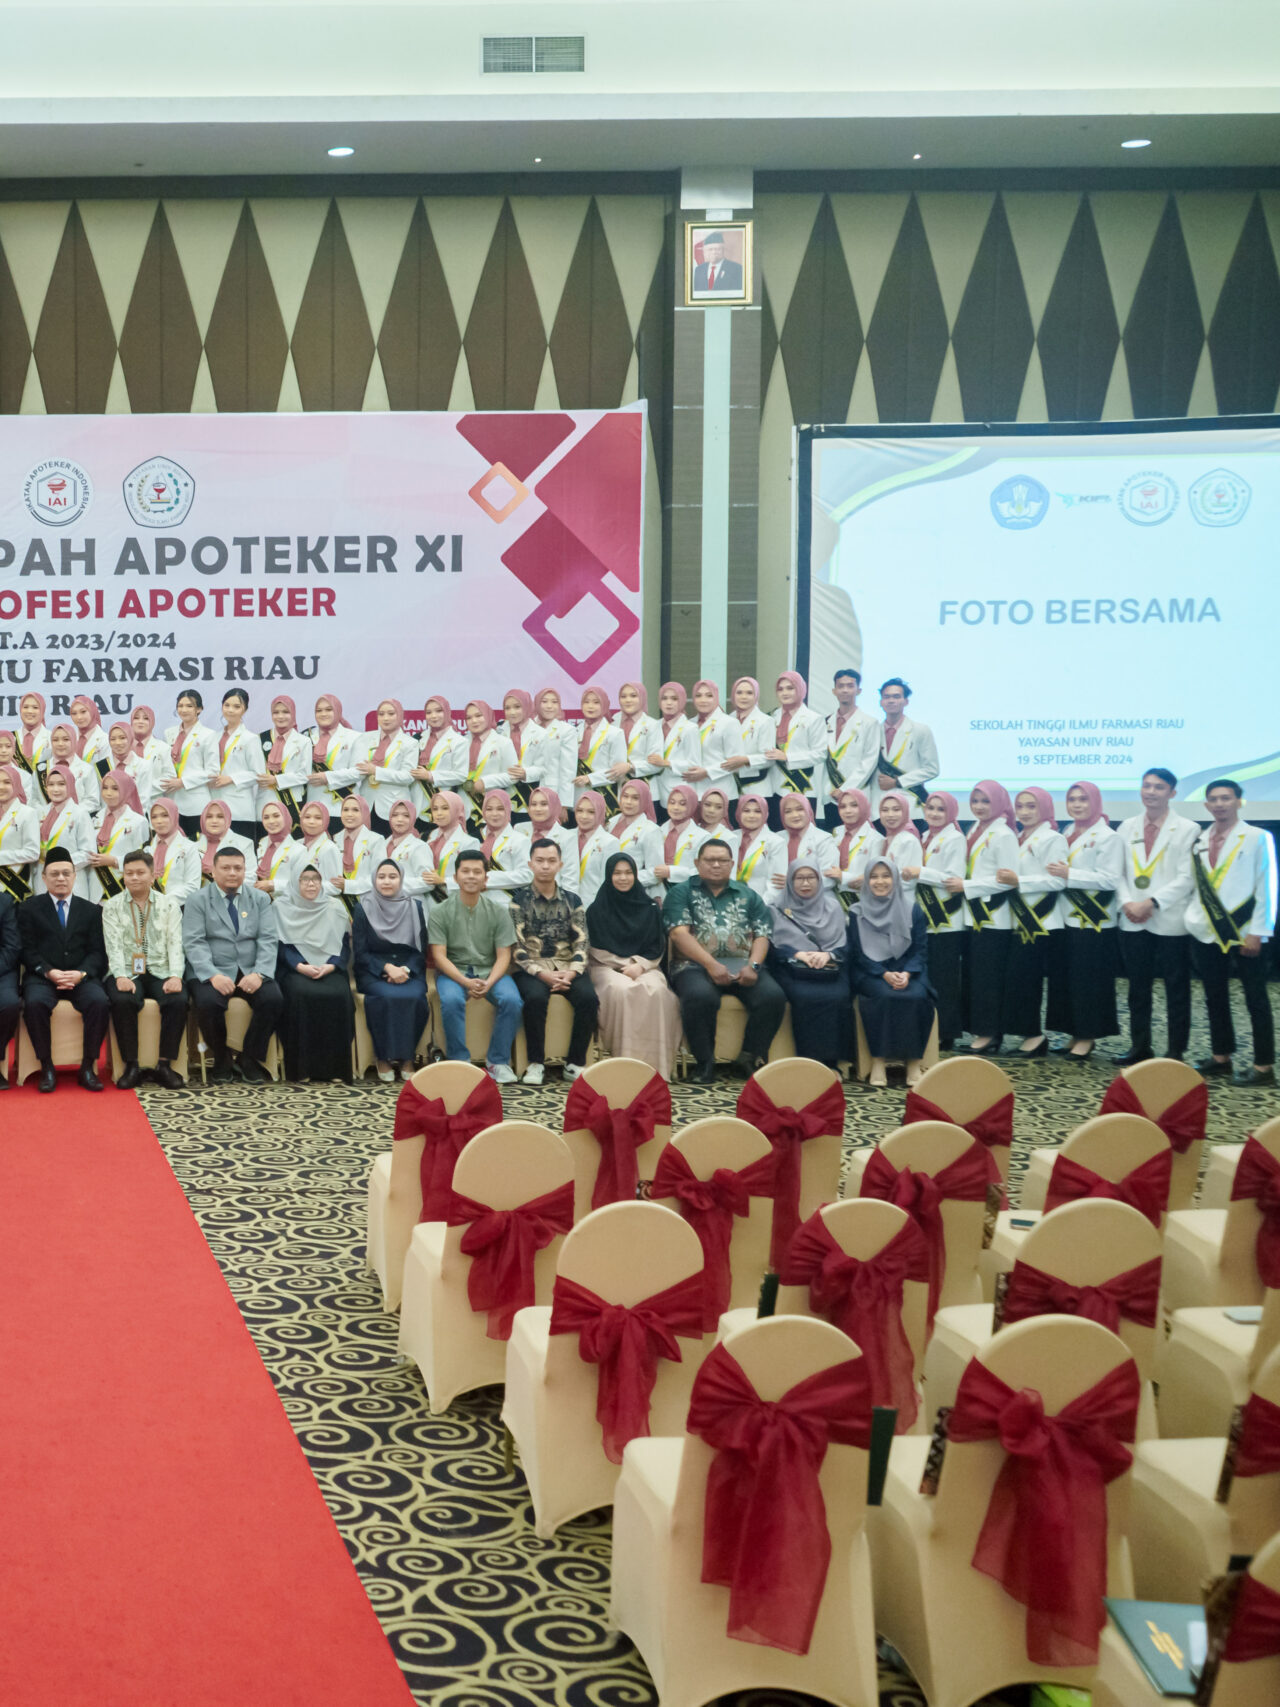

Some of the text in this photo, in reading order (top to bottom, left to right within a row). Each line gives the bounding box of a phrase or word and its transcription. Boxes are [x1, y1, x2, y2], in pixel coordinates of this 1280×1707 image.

[24, 460, 90, 511] IKATAN APOTEKER INDONESIA
[49, 497, 67, 507] IAI
[114, 536, 397, 575] APOTEKER
[416, 535, 462, 572] XI
[118, 588, 336, 618] APOTEKER
[940, 597, 1221, 625] FOTO BERSAMA
[46, 631, 176, 652] 2023/2024
[43, 657, 214, 683] FARMASI
[224, 656, 320, 680] RIAU
[50, 694, 134, 716] RAU
[970, 719, 1184, 731] SEKOLAH TINGGI ILMU FARMASI RIAU
[1019, 736, 1133, 747] YAYASAN UNIV RIAU
[1017, 754, 1133, 765] 19 SEPTEMBER 2024
